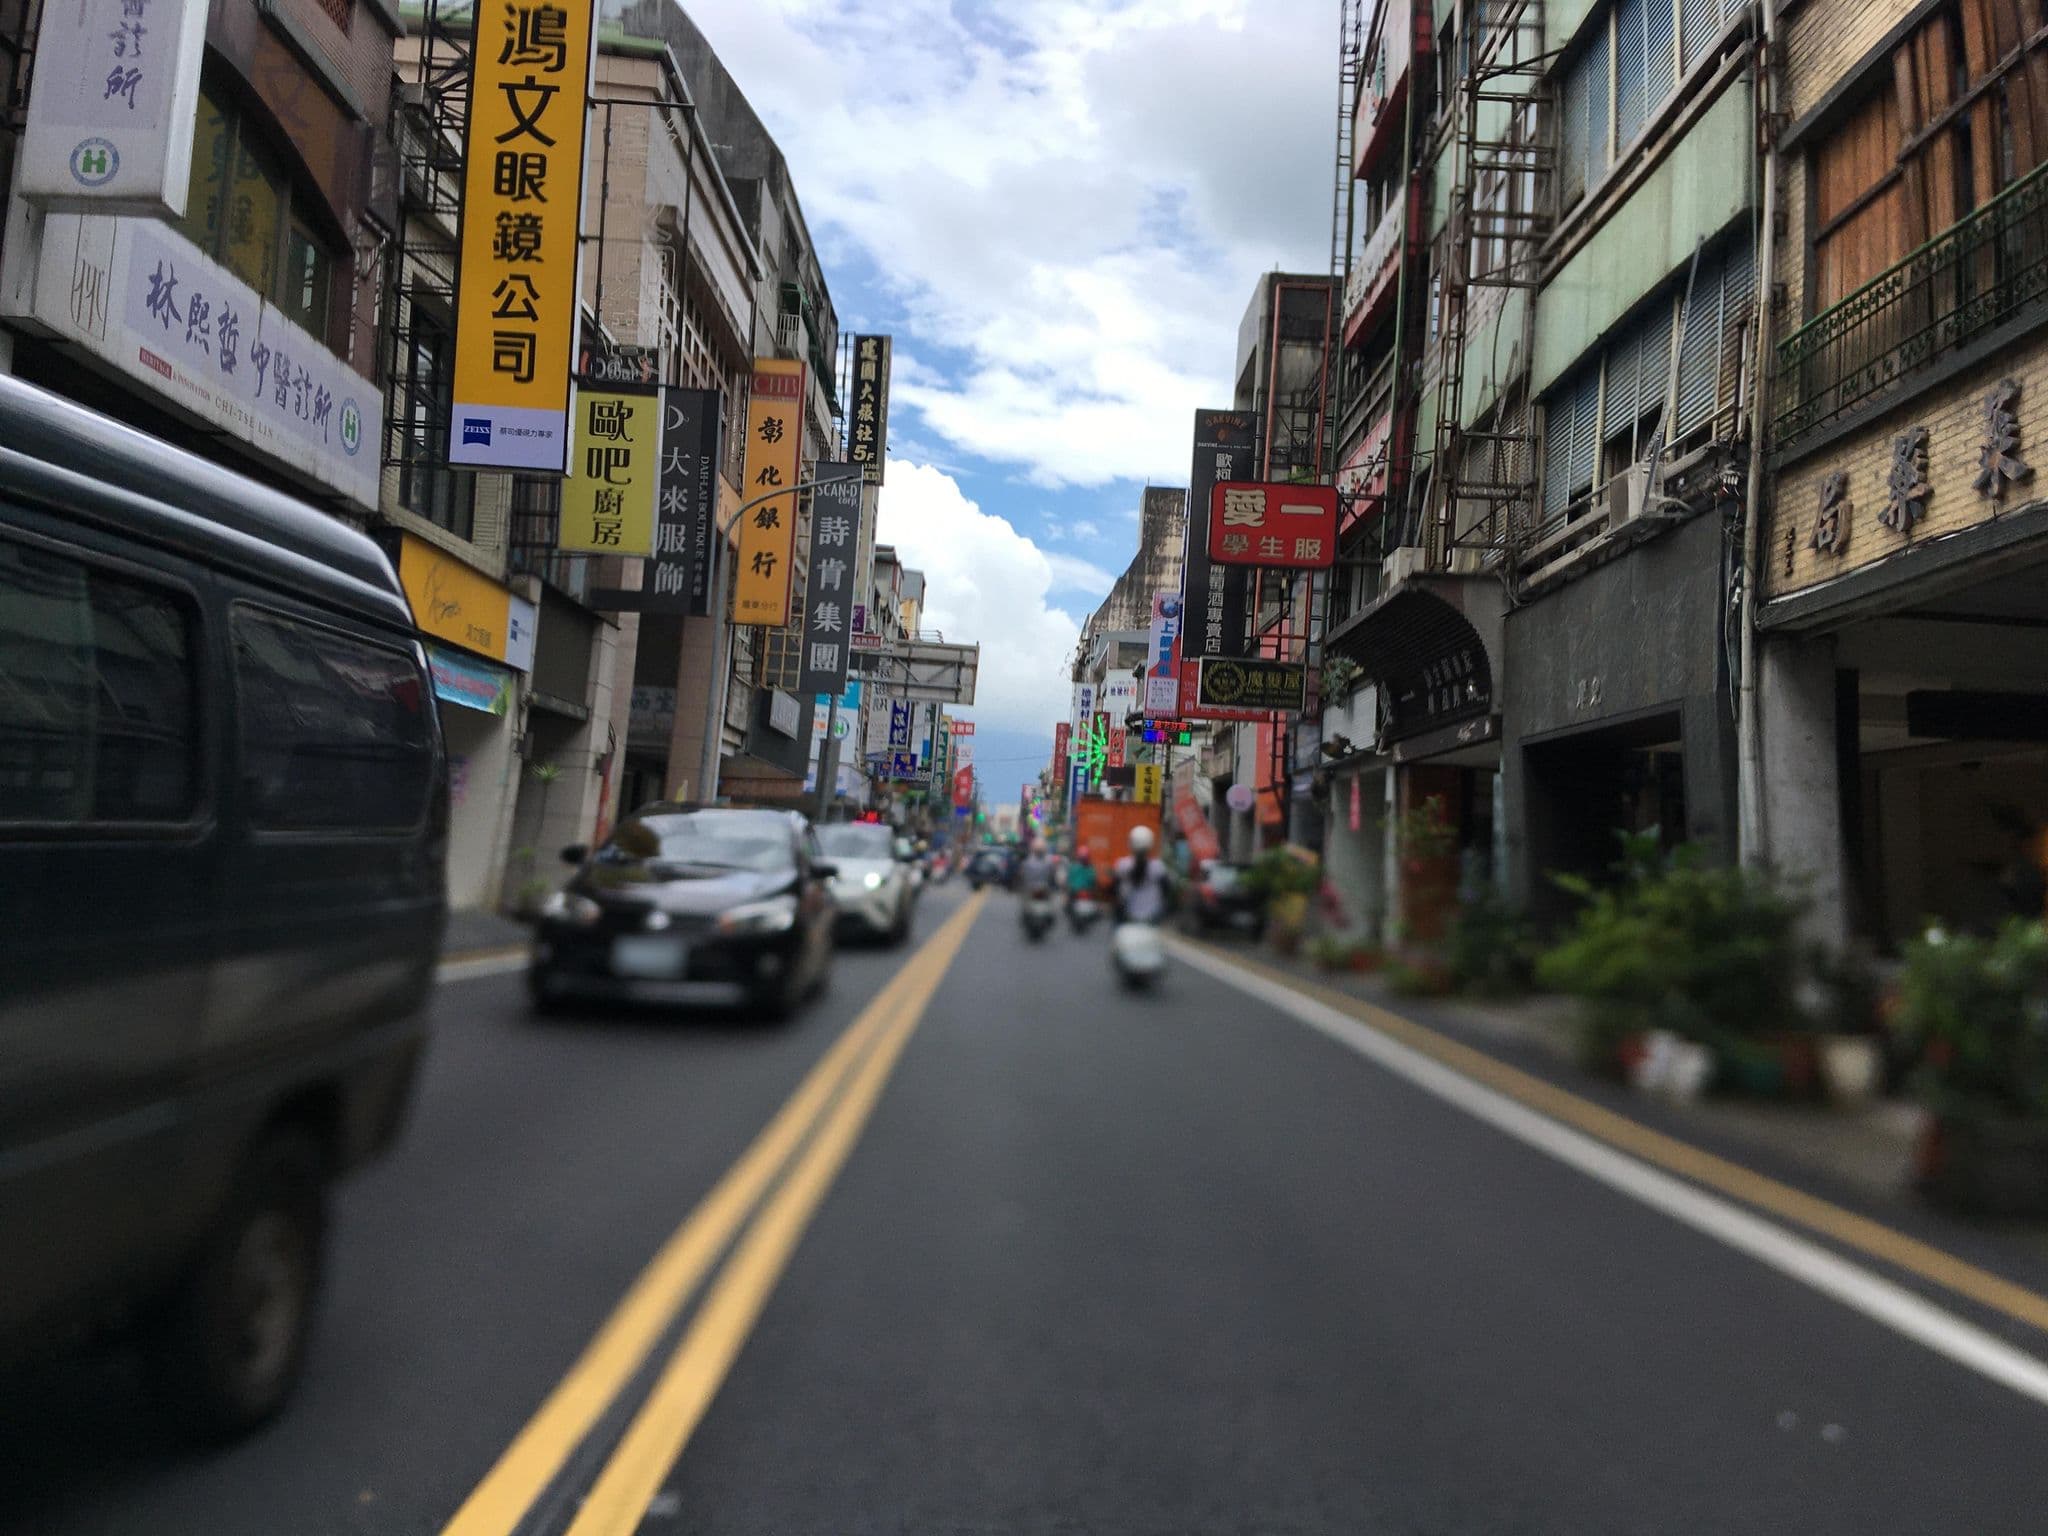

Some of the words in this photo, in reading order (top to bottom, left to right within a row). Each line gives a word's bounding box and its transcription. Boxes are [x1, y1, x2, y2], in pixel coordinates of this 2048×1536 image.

[492, 3, 567, 384] 鴻文眼鏡公司
[464, 425, 491, 434] ZEISS
[853, 445, 875, 462] 5F
[856, 337, 878, 442] 建國大旅社
[586, 400, 634, 546] 歐吧廚房
[653, 446, 691, 596] 大來服飾
[752, 416, 784, 580] 彰化銀行
[810, 516, 850, 673] 詩肯集團
[1222, 534, 1322, 560] 學生服
